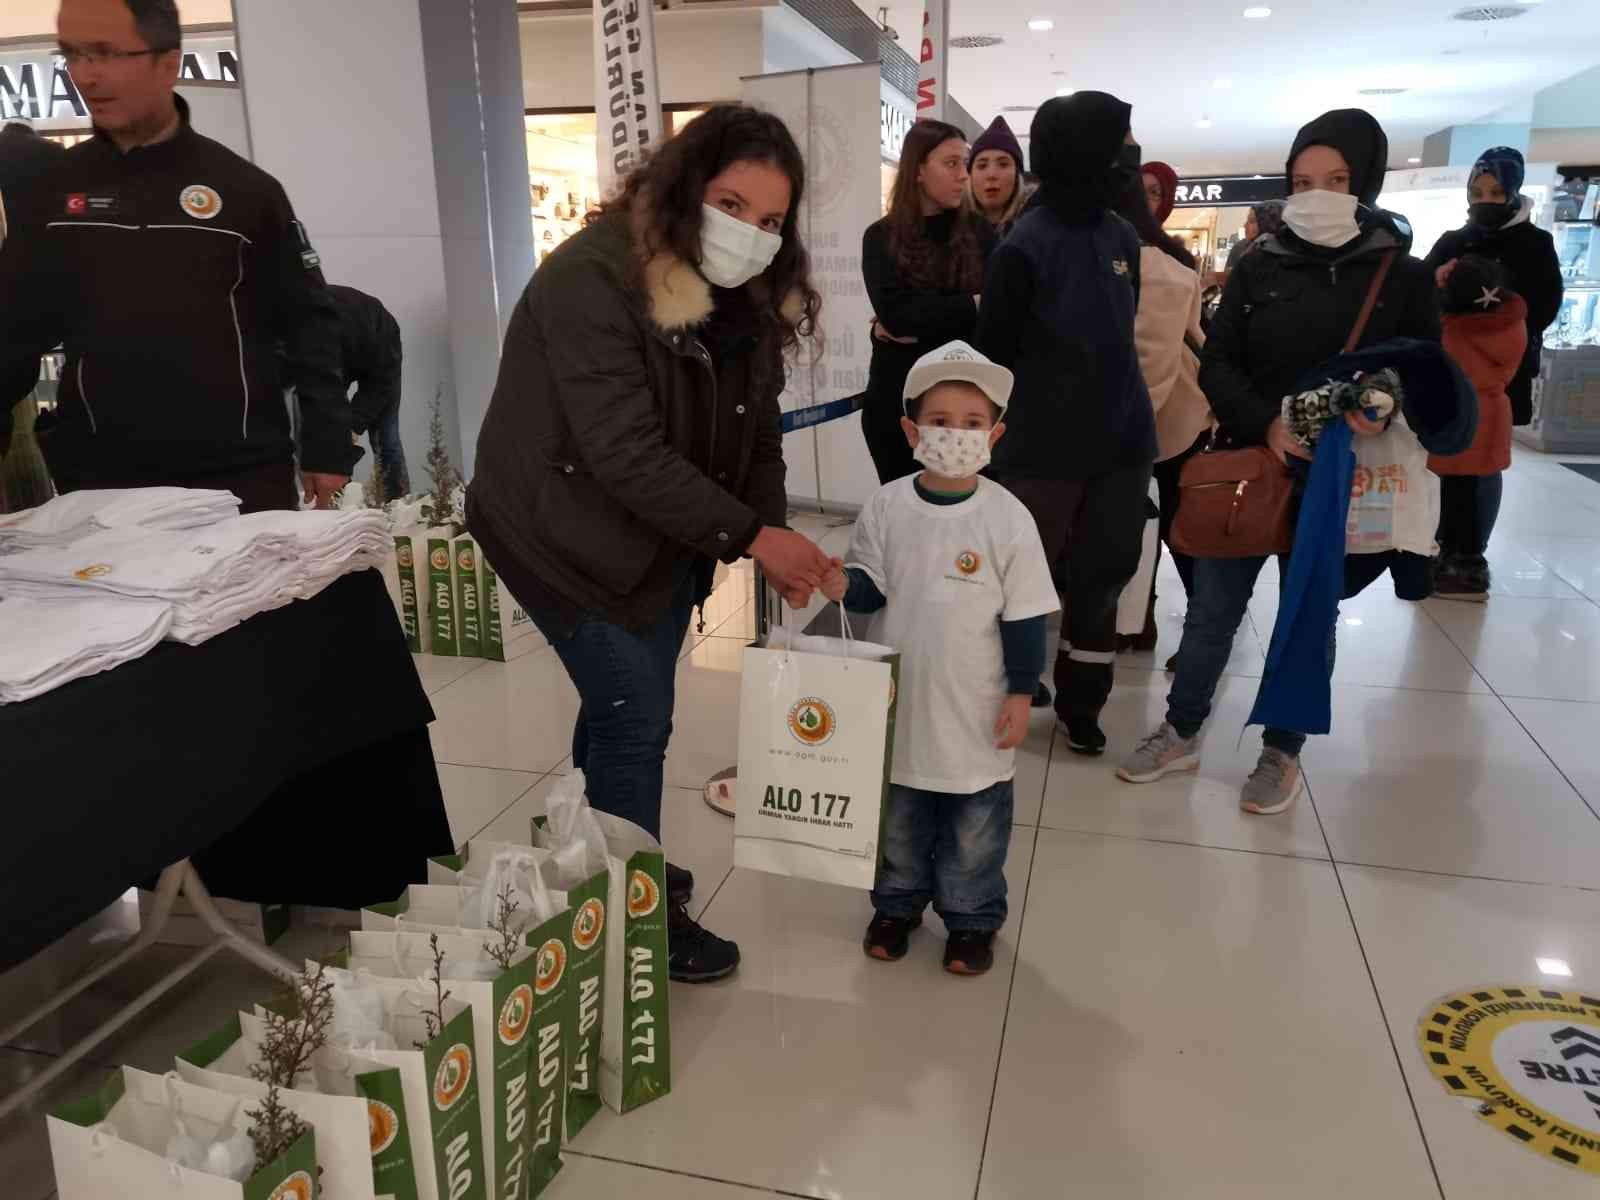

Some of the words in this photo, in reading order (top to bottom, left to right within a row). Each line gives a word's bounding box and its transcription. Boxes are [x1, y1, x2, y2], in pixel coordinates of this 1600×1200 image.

[401, 578, 415, 608] ALO
[436, 582, 450, 609] ALO
[464, 583, 477, 610] ALO
[437, 615, 451, 641] 177
[465, 616, 479, 641] 177
[762, 784, 802, 813] ALO
[810, 791, 851, 819] 177
[630, 946, 654, 1003] ALO
[579, 975, 600, 1036] ALO
[538, 1021, 561, 1088] ALO
[569, 1036, 590, 1094] 177
[631, 1009, 655, 1066] 177
[505, 1071, 527, 1143] ALO
[532, 1088, 556, 1153] 177
[445, 1130, 473, 1200] ALO
